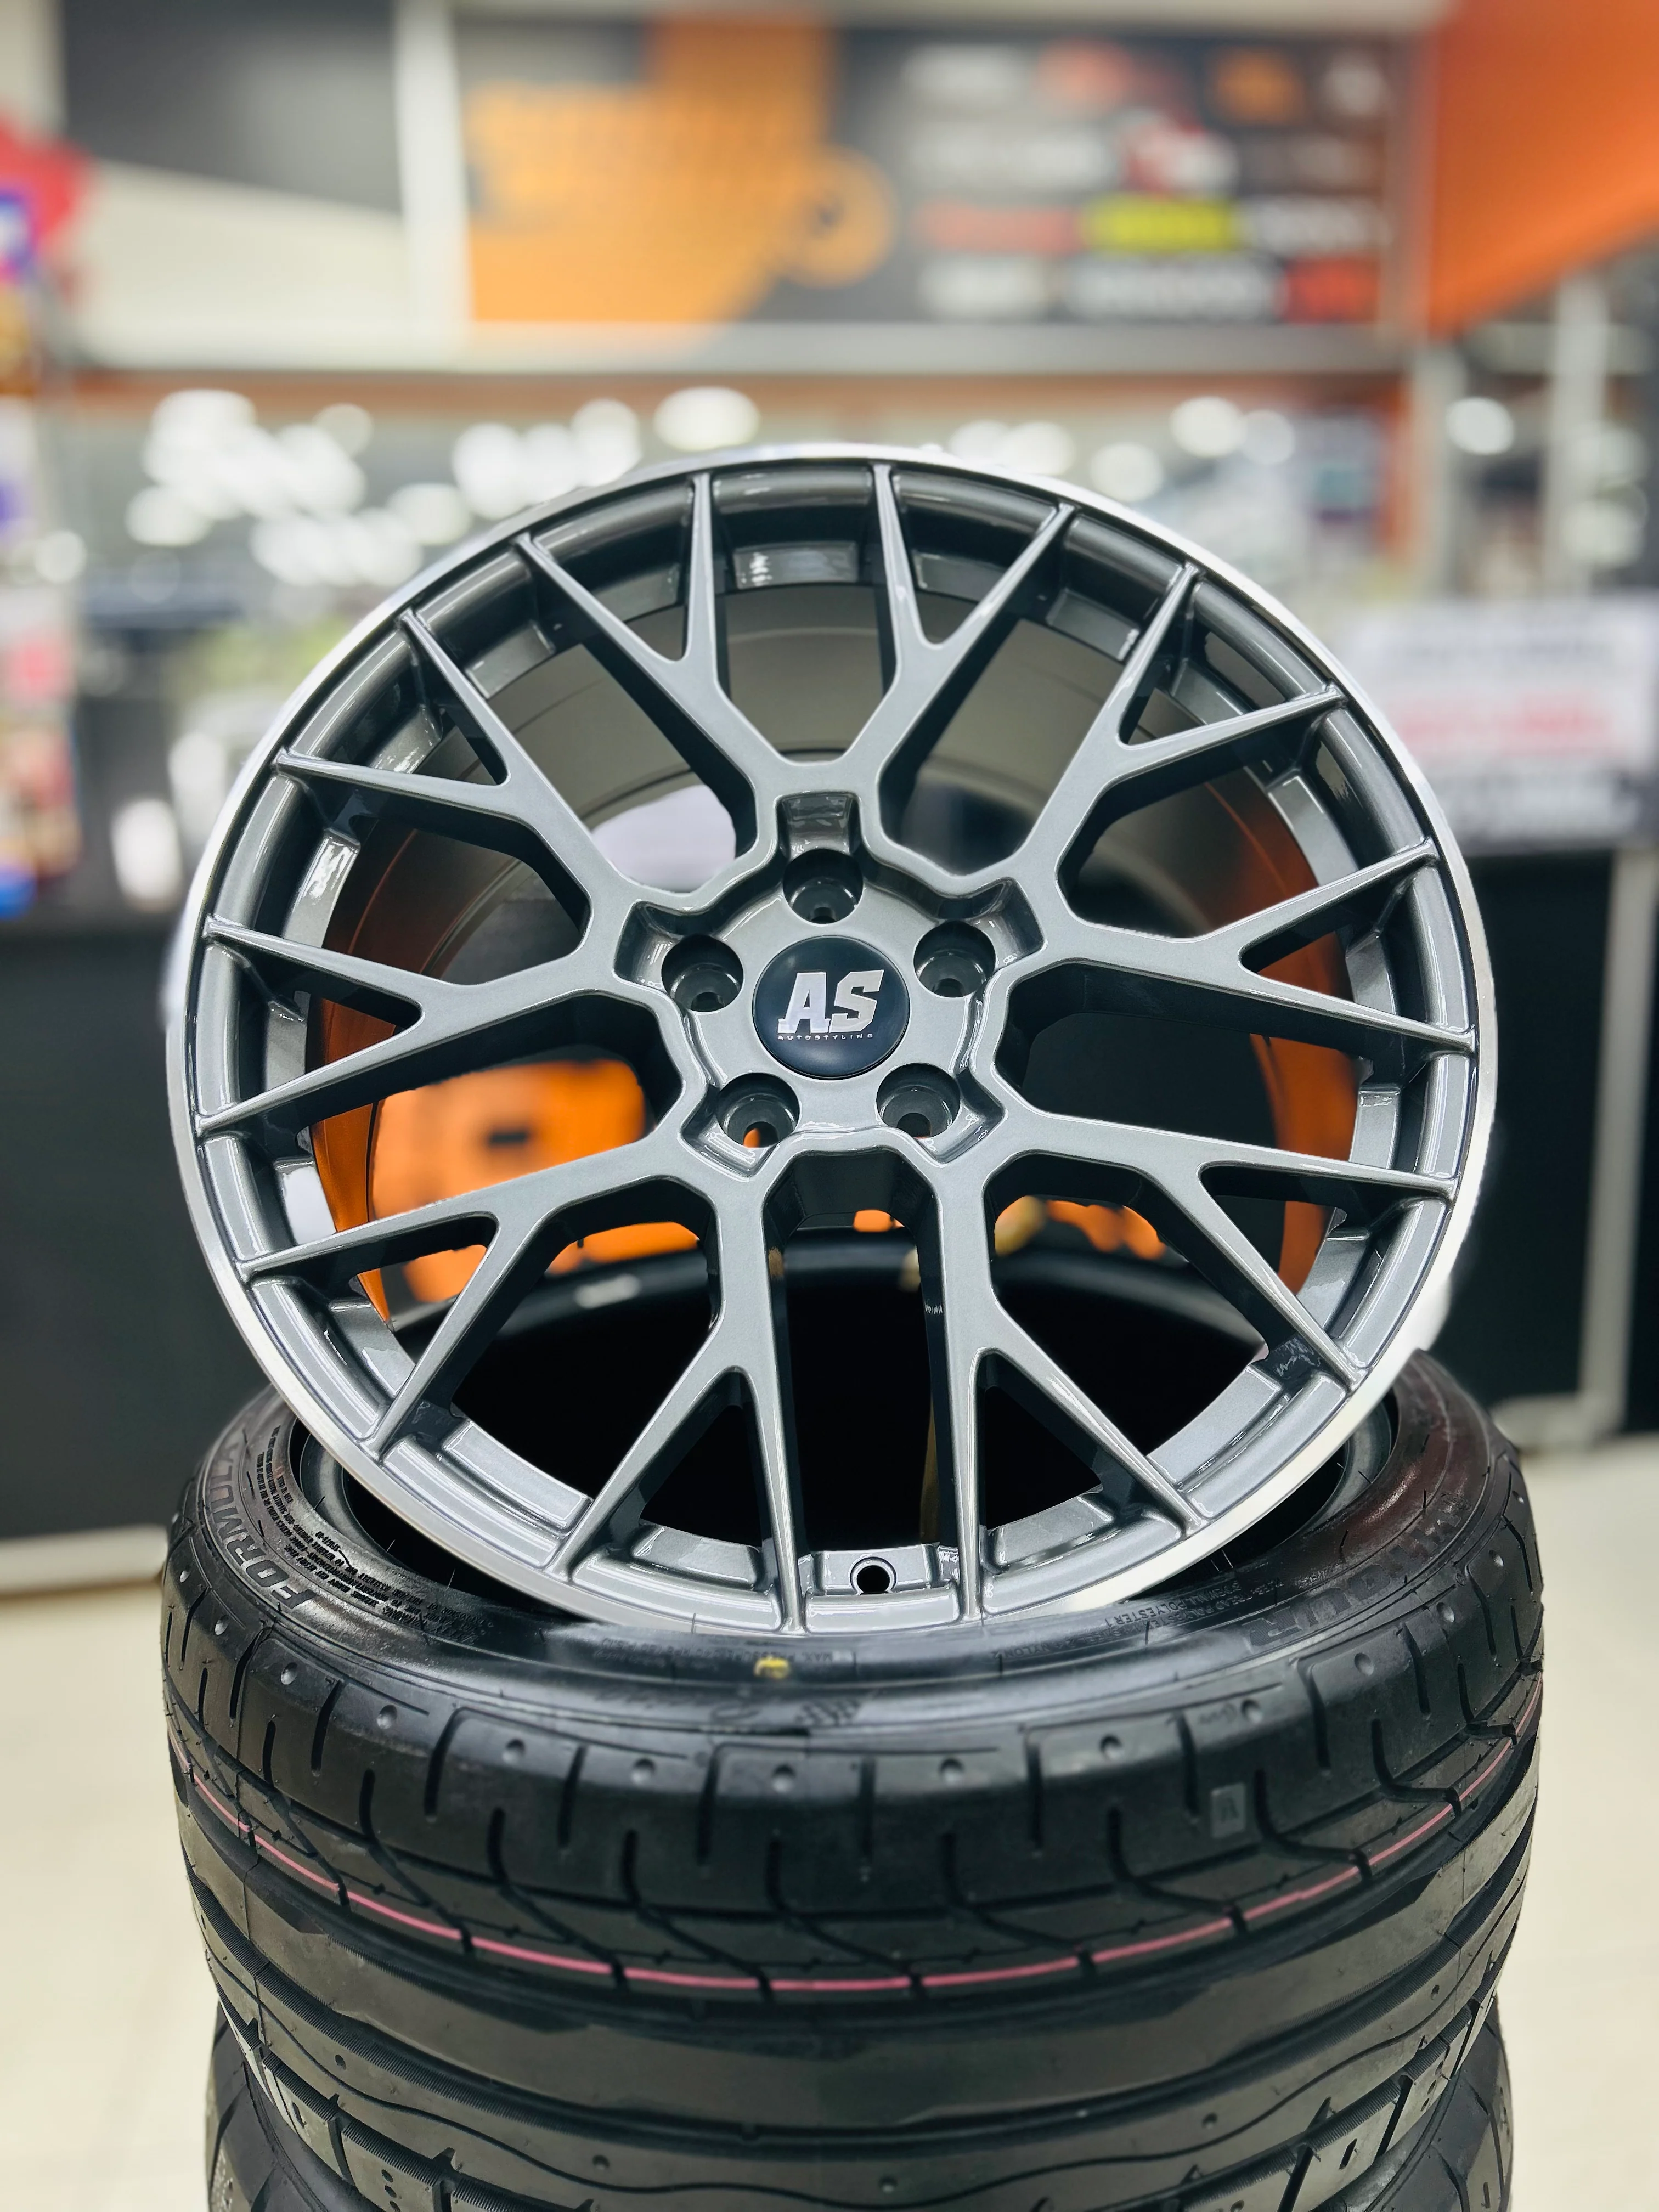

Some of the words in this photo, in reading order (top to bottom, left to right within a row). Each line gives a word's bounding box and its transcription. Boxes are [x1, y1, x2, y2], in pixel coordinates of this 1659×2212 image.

[777, 969, 884, 1034] AS
[210, 1432, 316, 1609] FORMULA
[1114, 1600, 1185, 1624] POLYESTER
